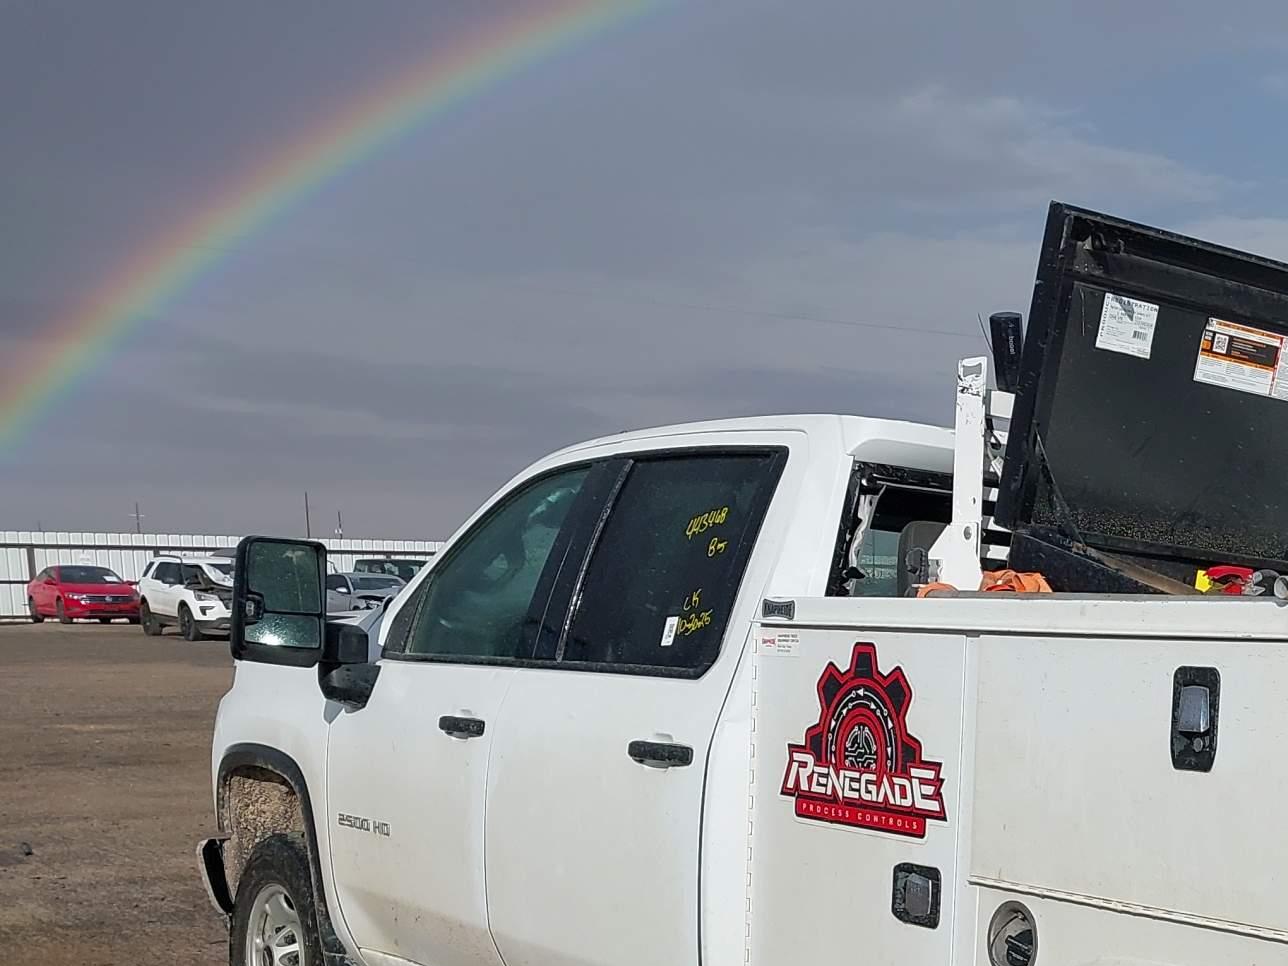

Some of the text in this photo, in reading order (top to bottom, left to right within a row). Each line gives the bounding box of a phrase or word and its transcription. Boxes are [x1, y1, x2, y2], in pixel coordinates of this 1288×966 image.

[786, 752, 941, 812] RENEGADE
[338, 813, 391, 837] 2500 HD
[801, 802, 919, 830] PROCESS CONTROLS
